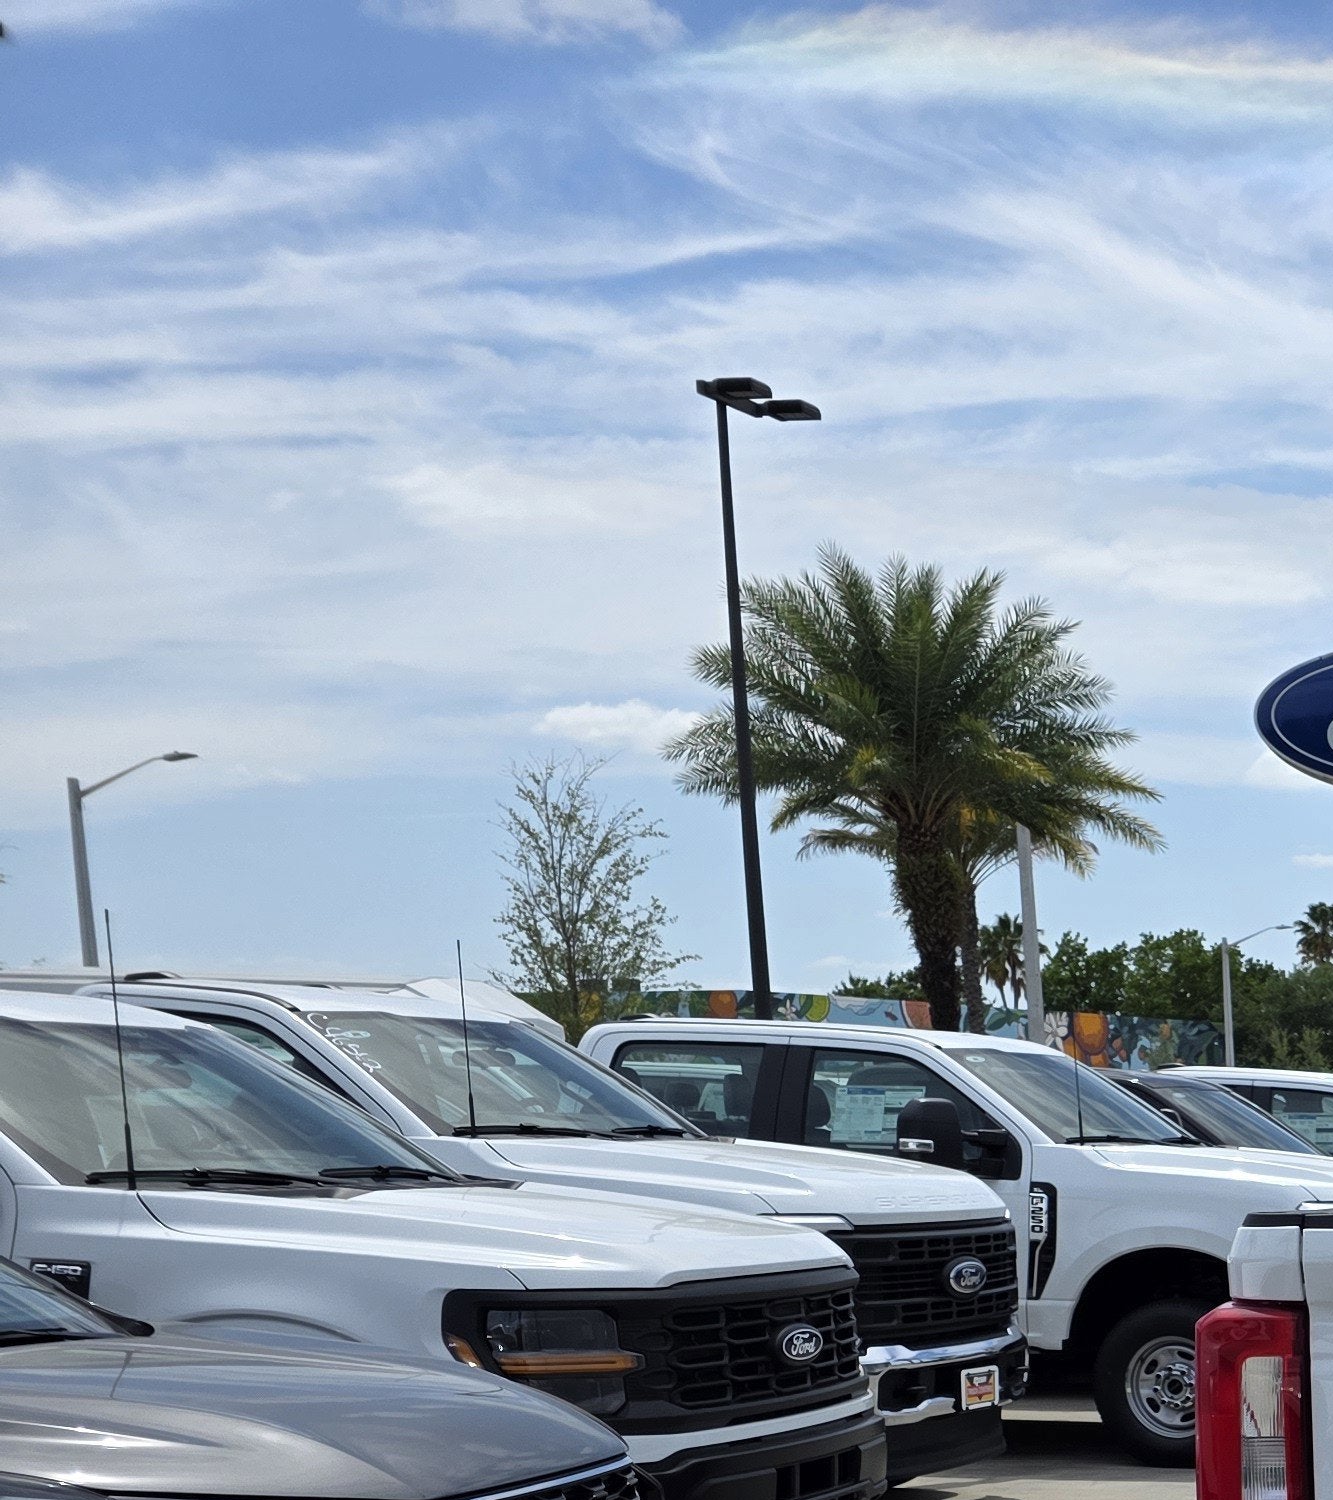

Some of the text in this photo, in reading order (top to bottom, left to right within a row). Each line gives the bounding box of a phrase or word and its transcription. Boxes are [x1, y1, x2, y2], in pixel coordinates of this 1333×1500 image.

[33, 1263, 82, 1276] F-150
[961, 1268, 980, 1287] Ford
[791, 1333, 816, 1356] Ford
